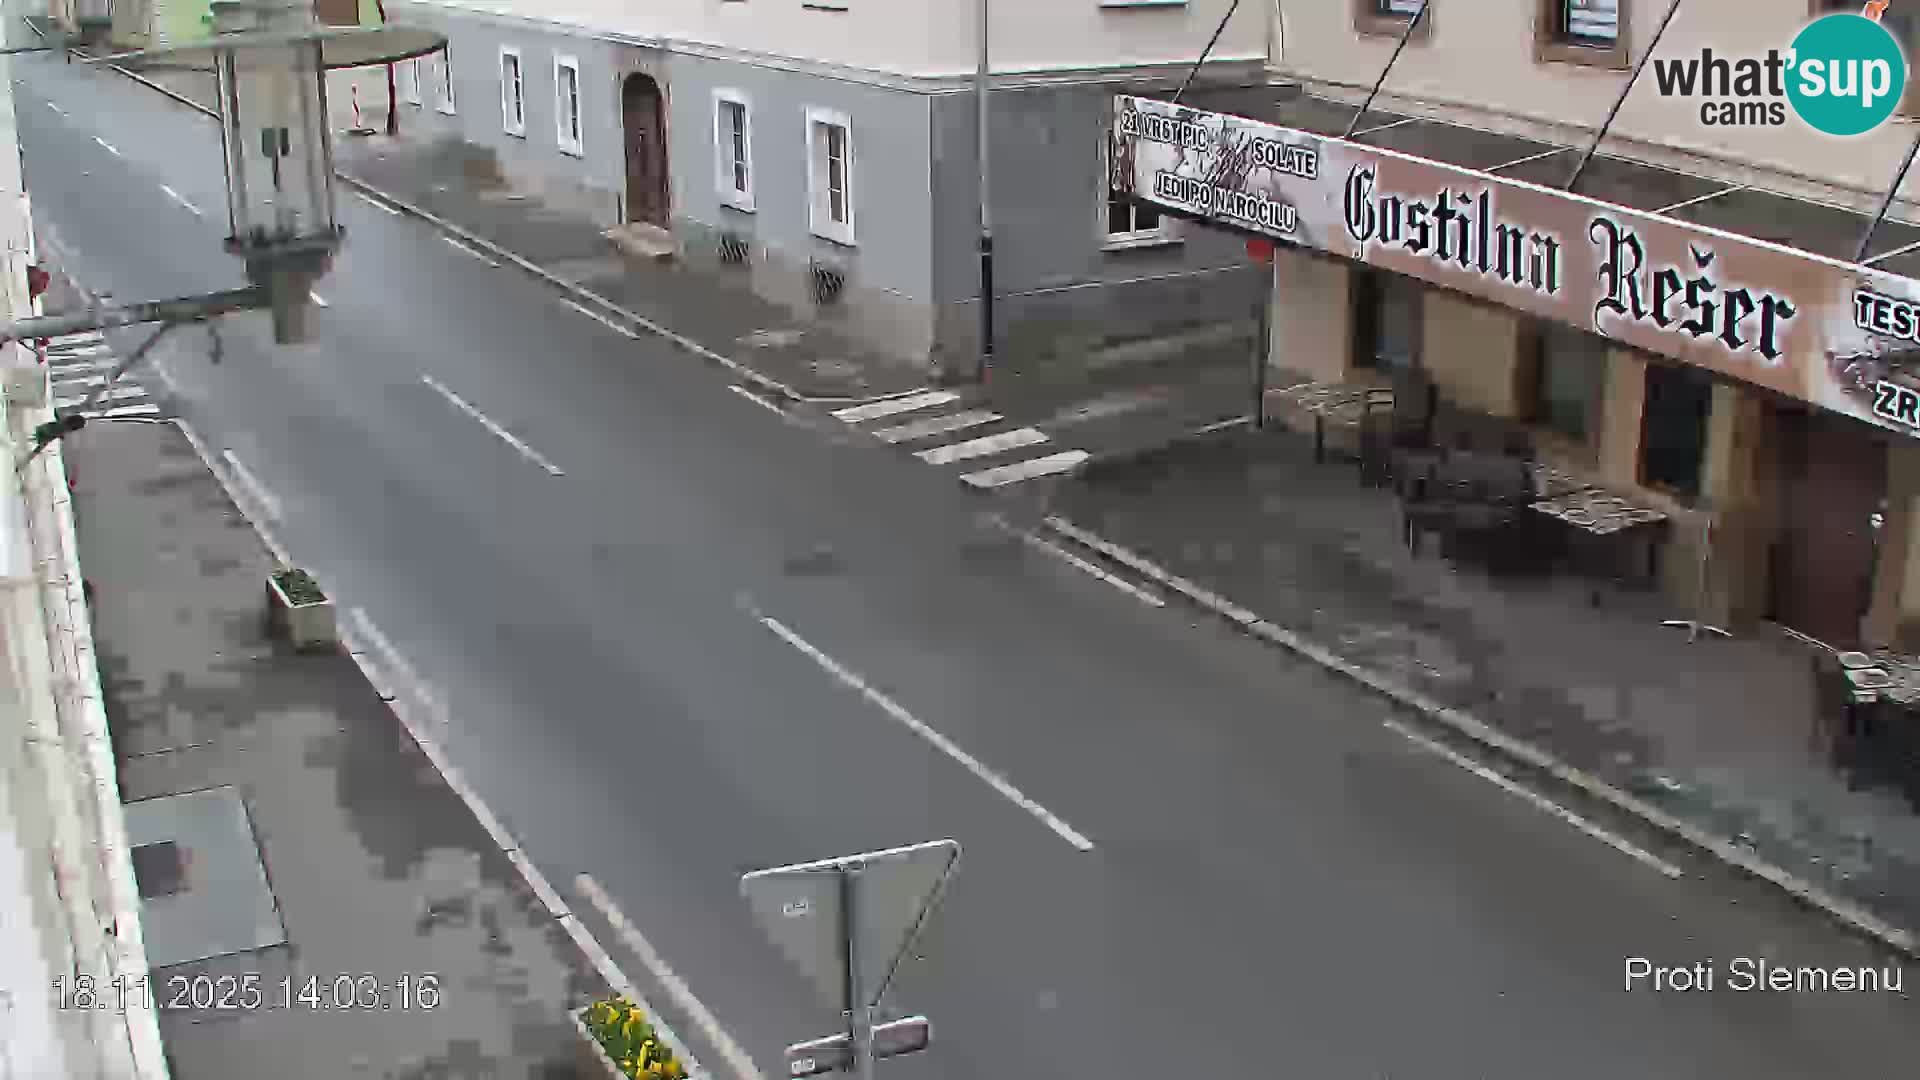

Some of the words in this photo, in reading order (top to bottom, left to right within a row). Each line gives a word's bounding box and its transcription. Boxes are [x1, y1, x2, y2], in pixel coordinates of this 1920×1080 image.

[1183, 123, 1208, 149] PIC
[1252, 138, 1317, 177] SOLATE
[1190, 180, 1212, 208] PO
[1344, 163, 1560, 296] Gostilna
[1590, 217, 1796, 360] Rešer
